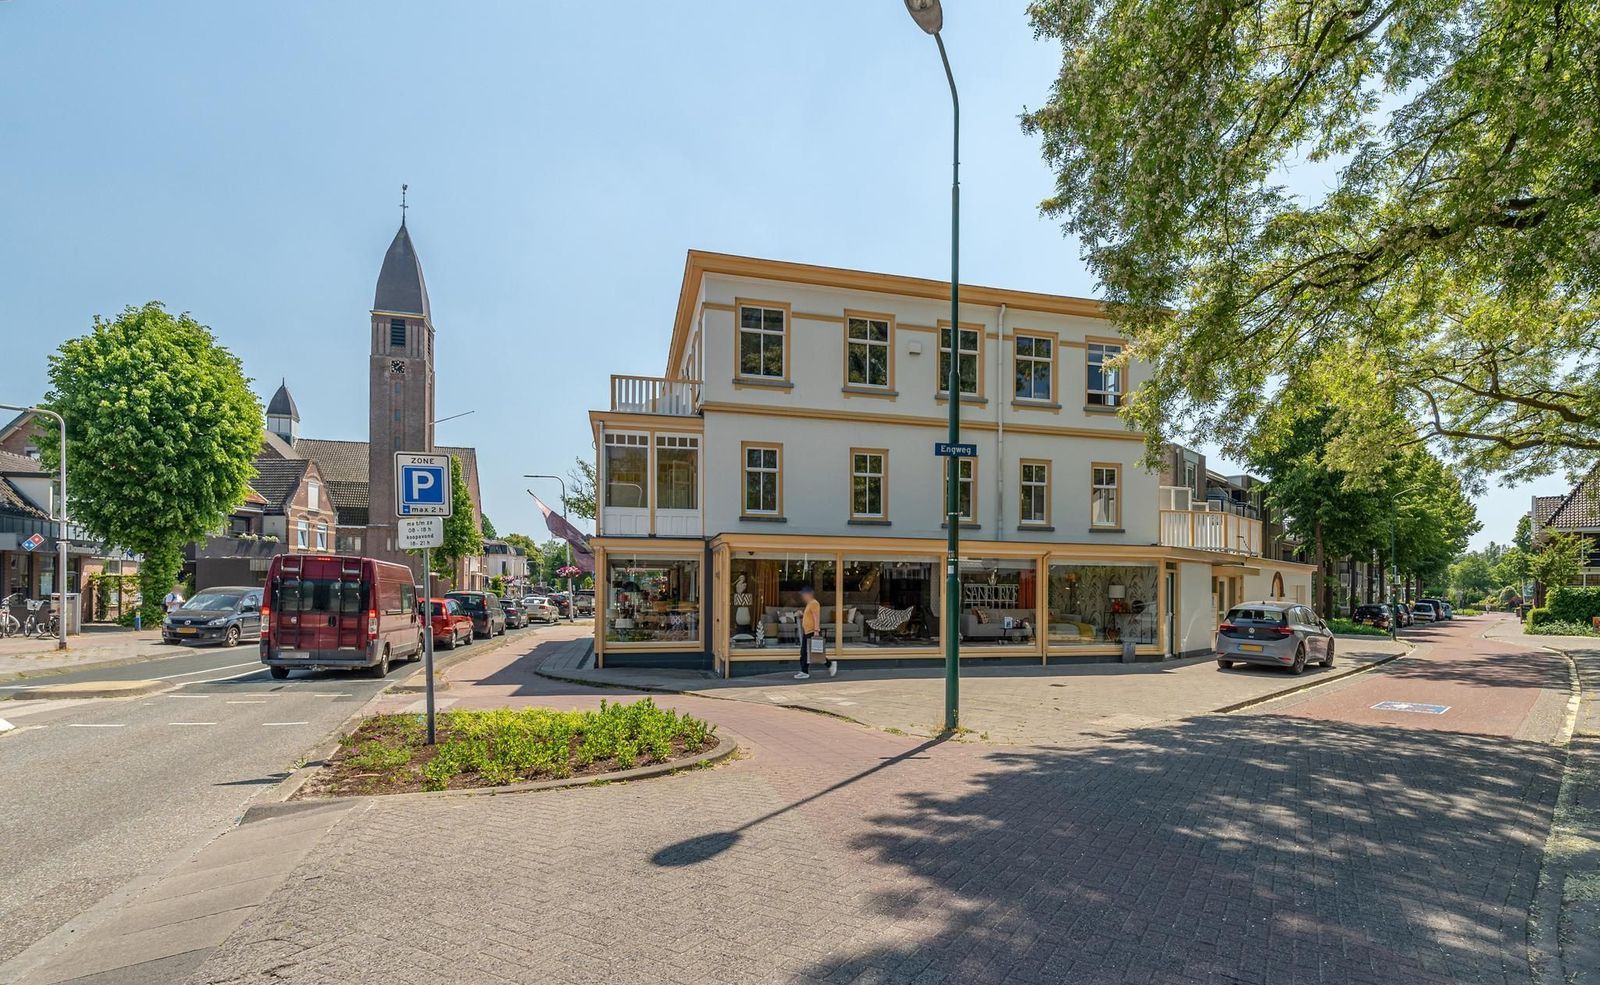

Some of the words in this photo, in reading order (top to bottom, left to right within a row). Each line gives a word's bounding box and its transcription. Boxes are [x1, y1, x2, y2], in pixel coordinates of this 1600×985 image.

[940, 445, 972, 456] Engweg
[411, 457, 435, 465] ZONE
[412, 471, 435, 500] P
